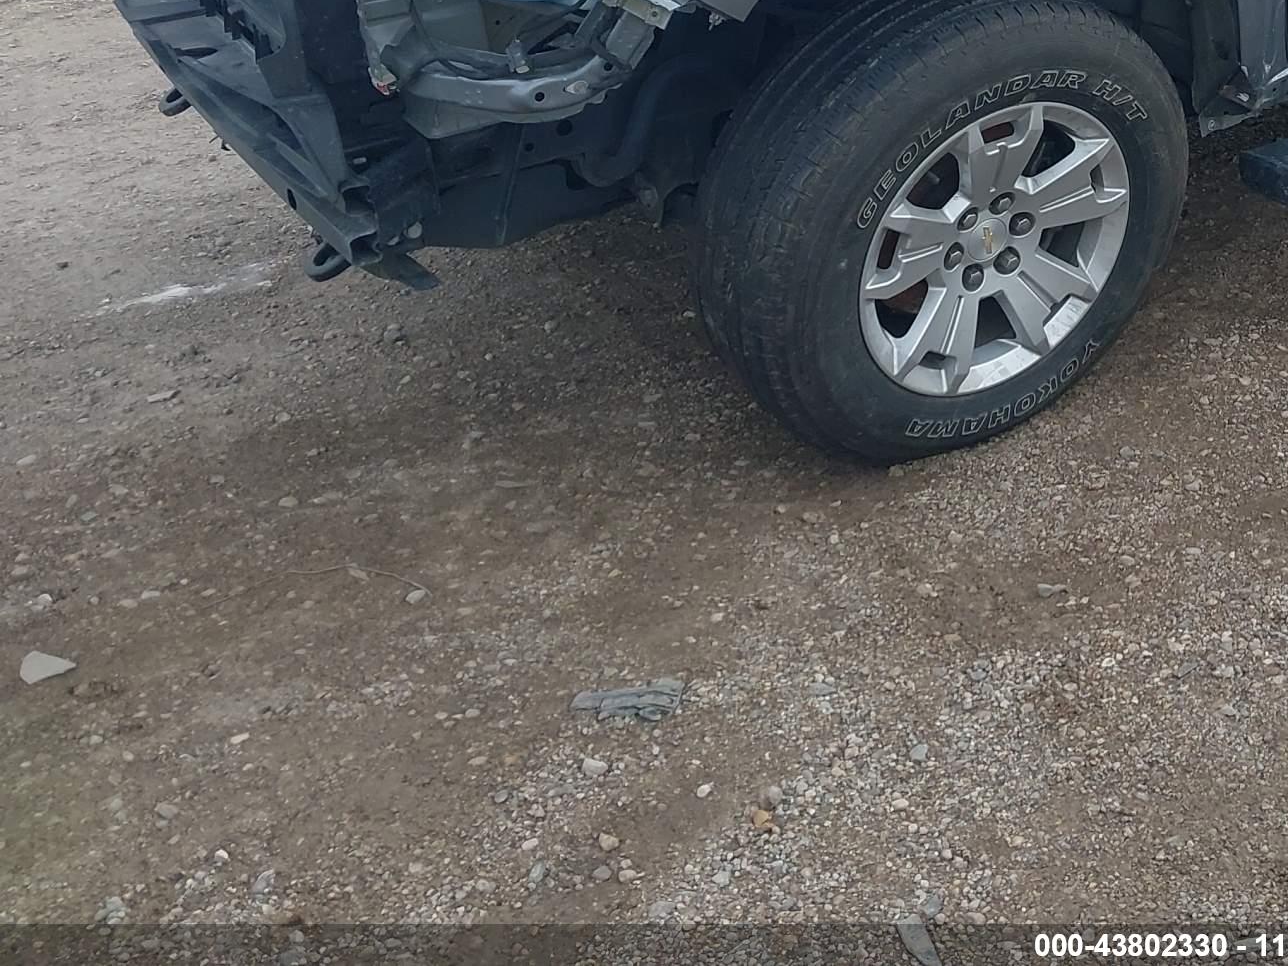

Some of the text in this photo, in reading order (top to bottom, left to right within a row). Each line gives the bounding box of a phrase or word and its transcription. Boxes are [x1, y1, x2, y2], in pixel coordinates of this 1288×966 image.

[856, 70, 1150, 230] GEOLANDAR H/T
[905, 338, 1101, 437] YOKOHAMA
